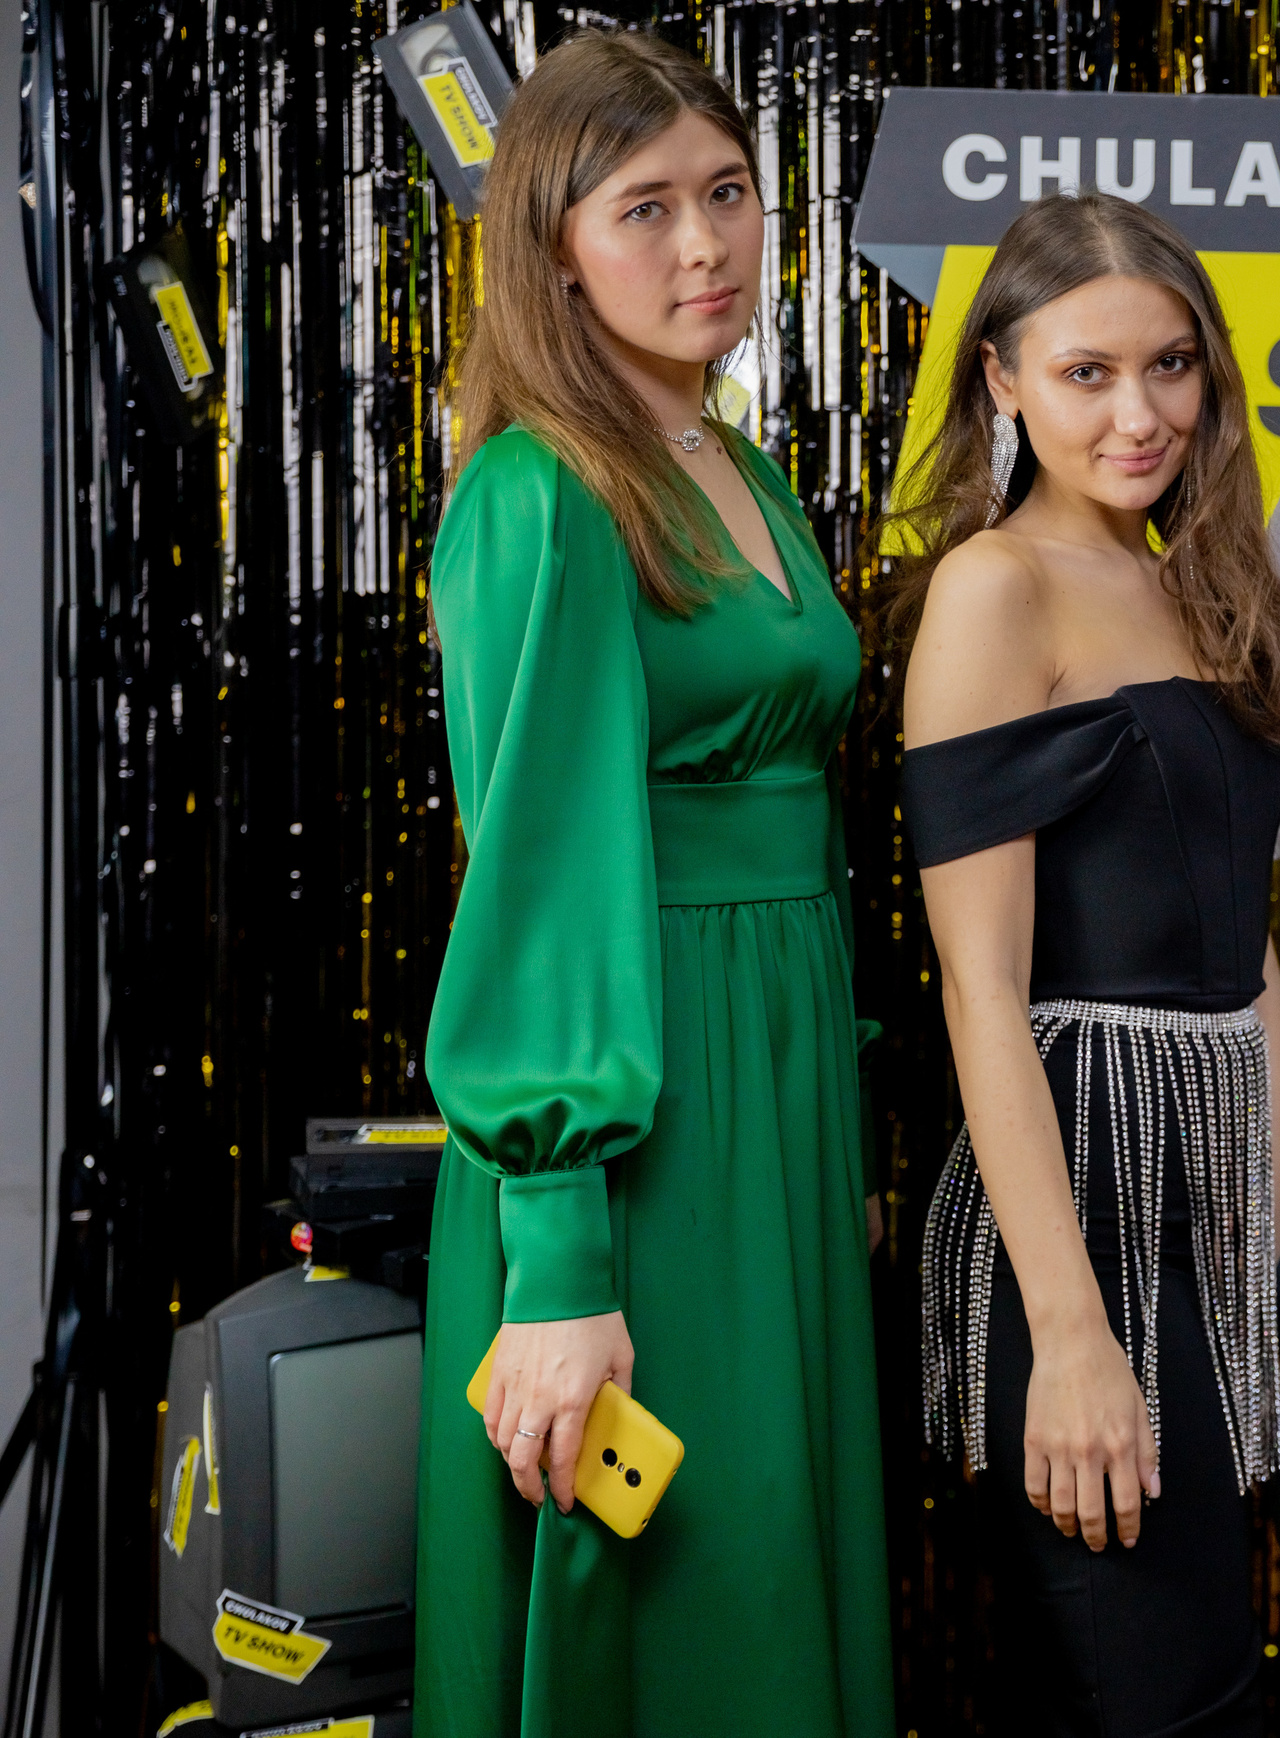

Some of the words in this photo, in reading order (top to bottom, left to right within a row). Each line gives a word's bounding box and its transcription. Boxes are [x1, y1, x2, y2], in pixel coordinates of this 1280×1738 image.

[440, 84, 456, 103] TV
[450, 105, 479, 150] SHOW
[225, 1600, 290, 1632] CHULAKOV
[224, 1625, 248, 1645] TV
[246, 1635, 305, 1665] SHOW
